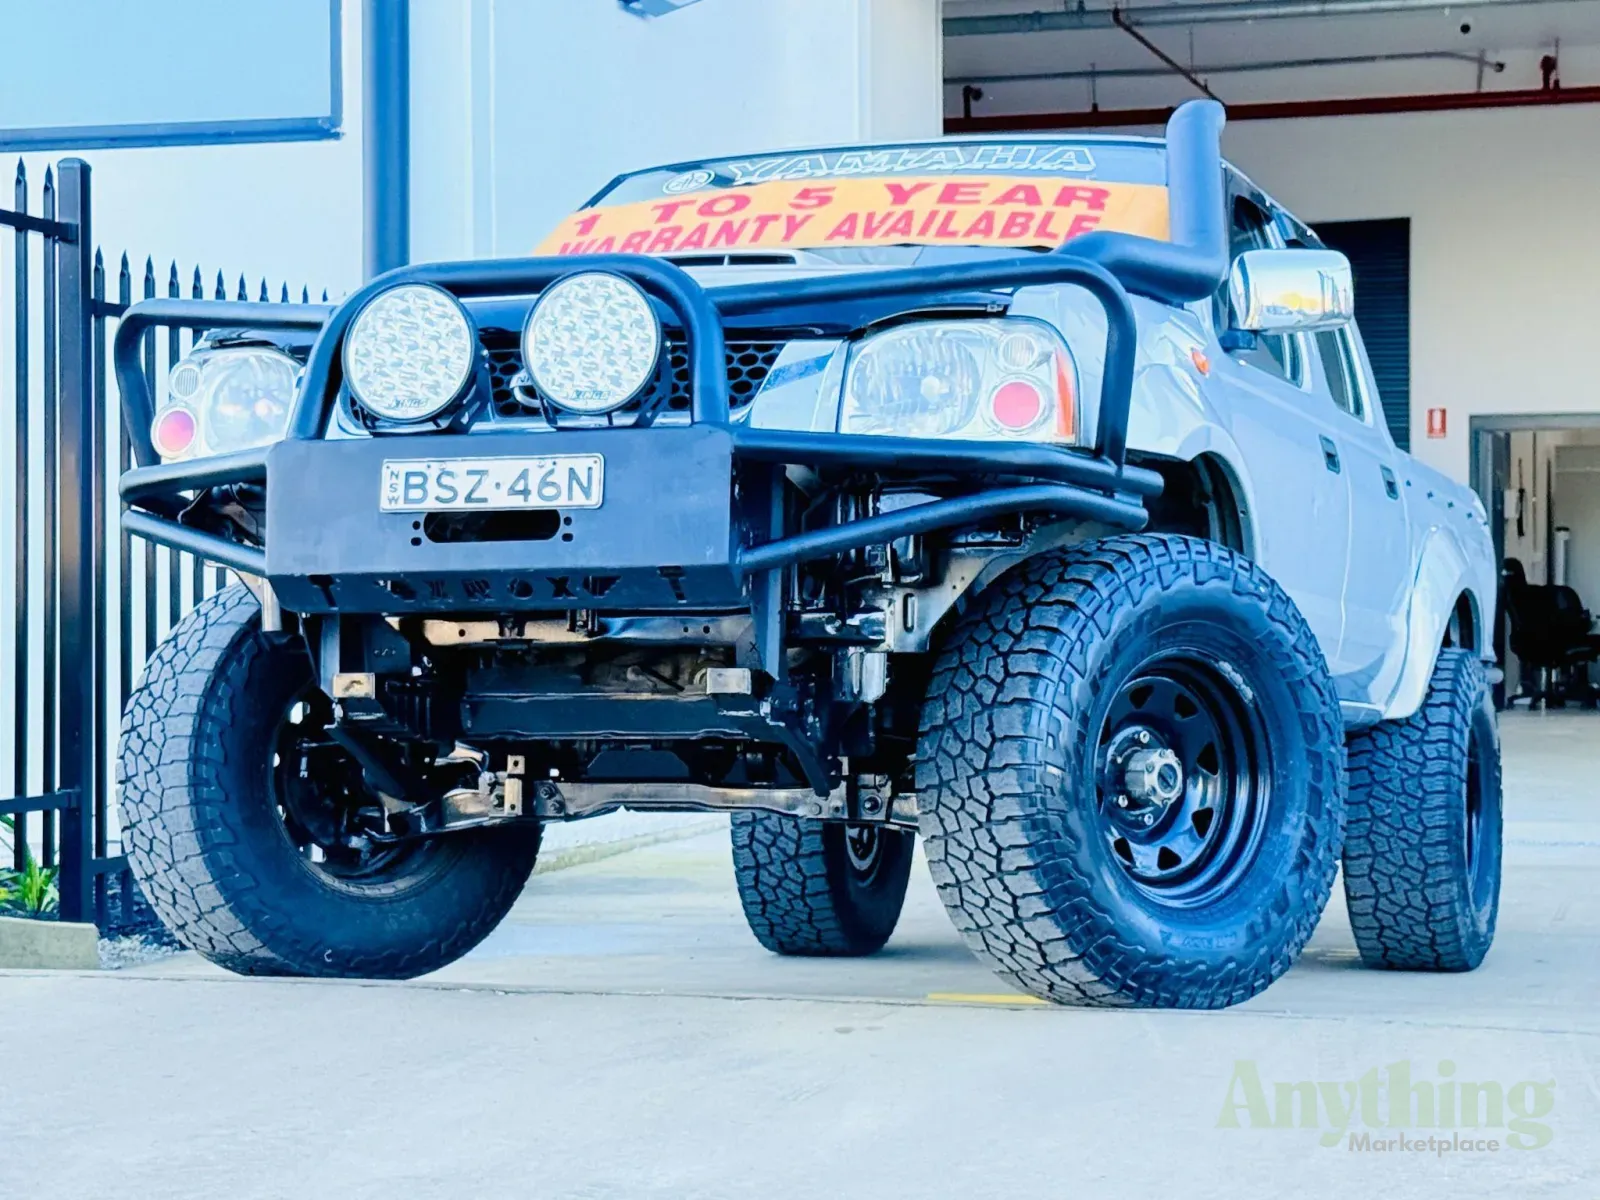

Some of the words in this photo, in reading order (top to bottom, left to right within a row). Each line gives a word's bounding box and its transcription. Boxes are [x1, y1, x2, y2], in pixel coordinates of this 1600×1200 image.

[728, 145, 1096, 185] YAMAHA
[558, 213, 816, 255] WARRANTY
[824, 209, 1102, 243] AVAILABLE
[575, 213, 602, 236] 1
[651, 194, 752, 223] TO
[788, 187, 837, 210] 5
[884, 182, 1111, 211] YEAR
